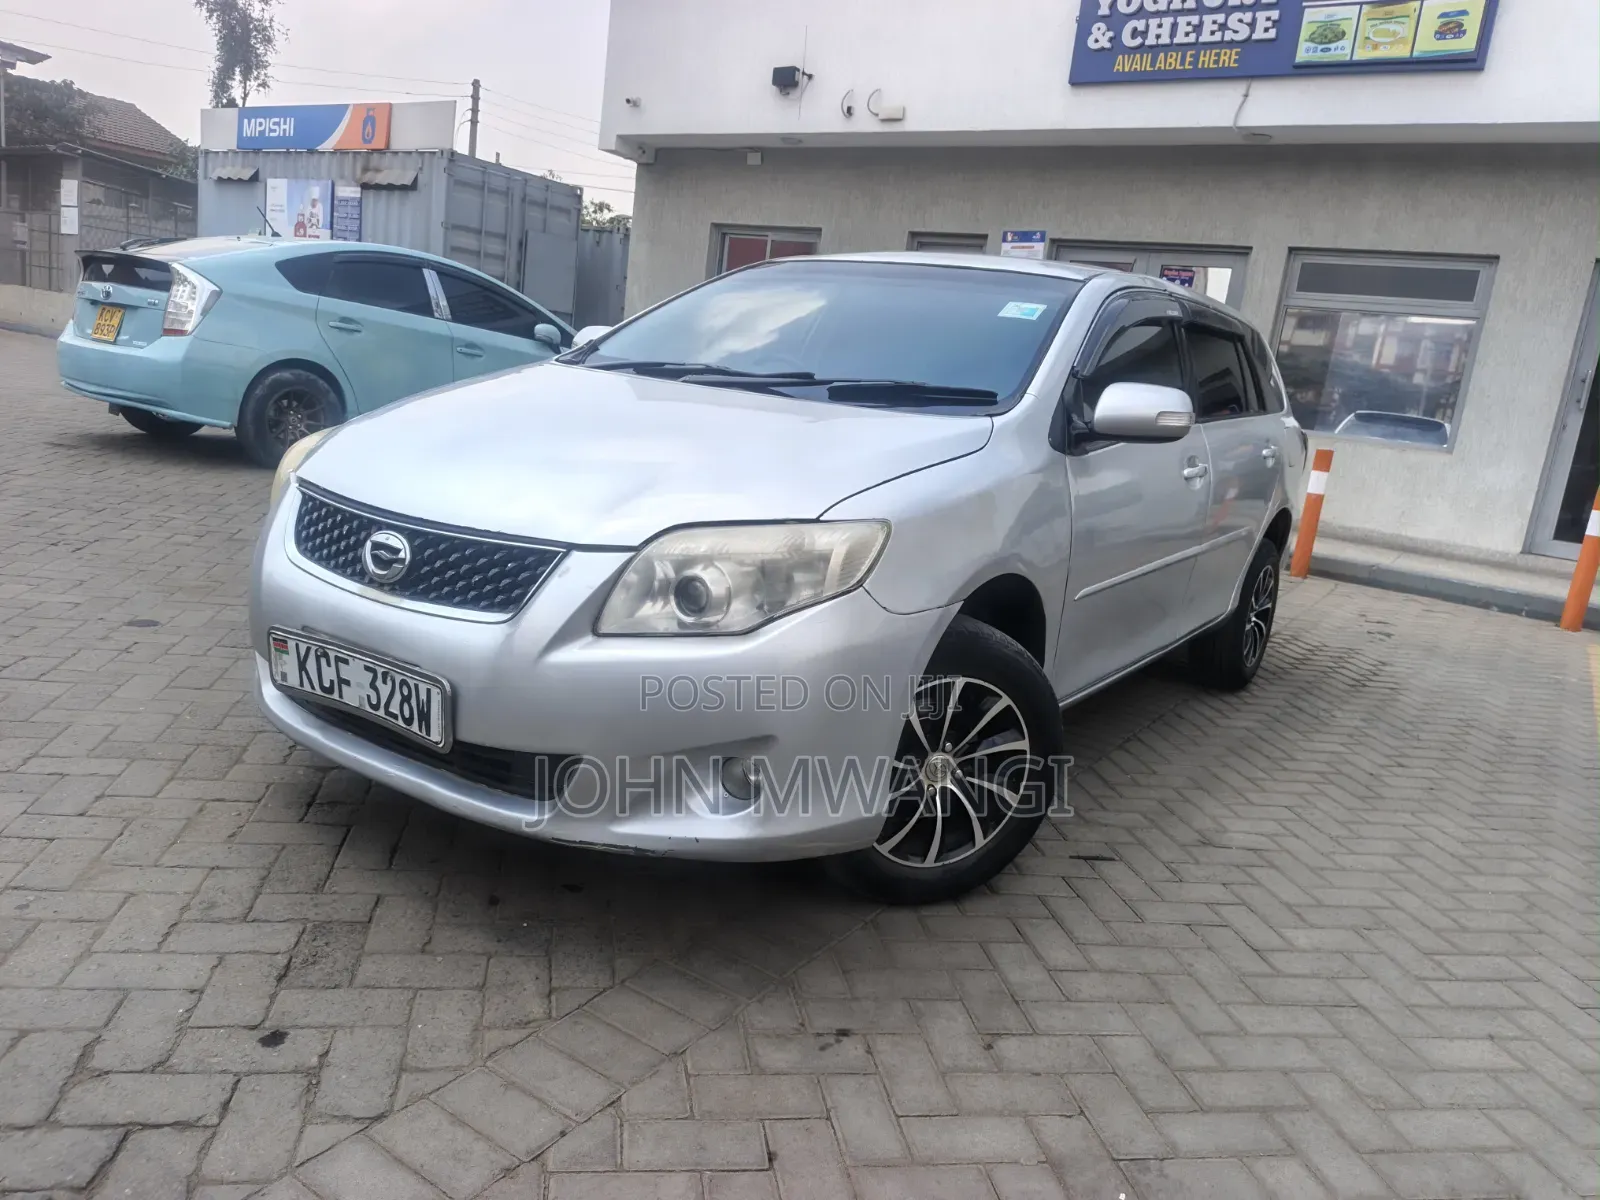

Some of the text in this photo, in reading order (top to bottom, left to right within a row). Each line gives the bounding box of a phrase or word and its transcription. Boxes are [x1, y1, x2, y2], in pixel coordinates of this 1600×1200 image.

[1087, 10, 1280, 50] & CHEESE
[1113, 49, 1240, 73] AVAILABLE HERE
[243, 117, 295, 137] MPISHI
[294, 642, 351, 699] KCF
[363, 664, 432, 738] 328W
